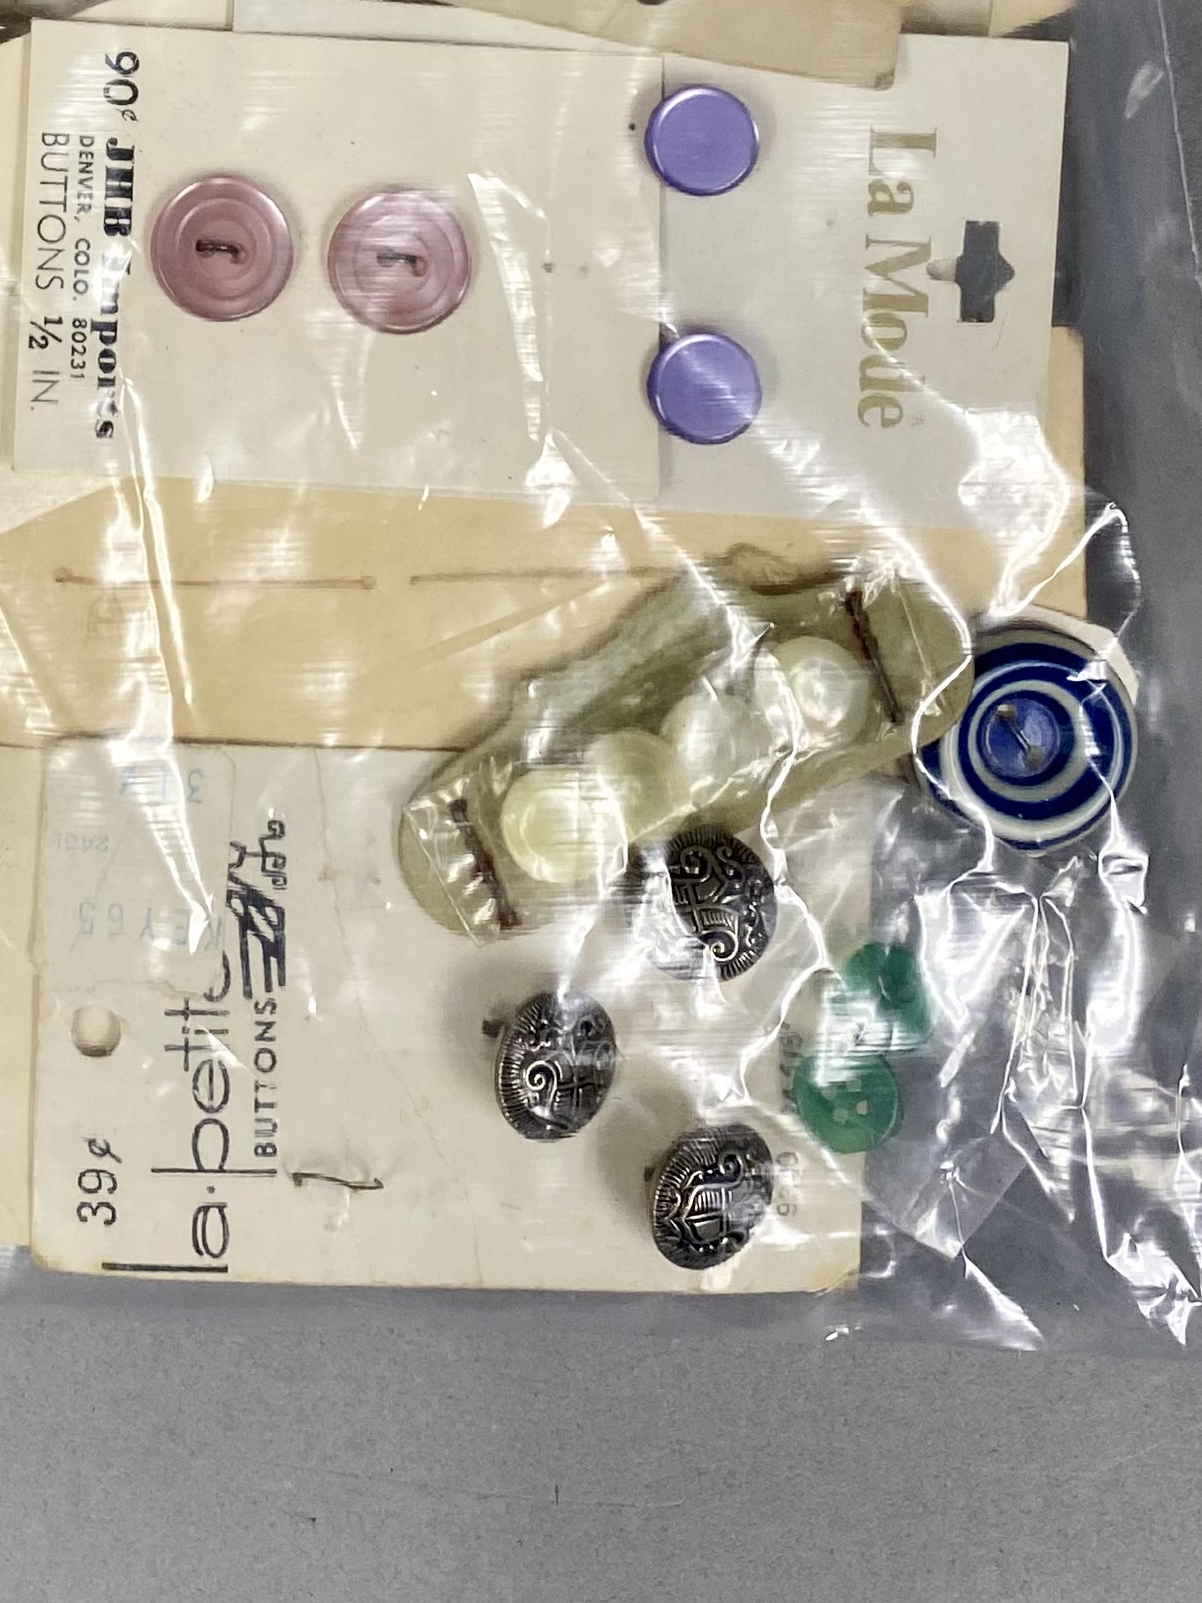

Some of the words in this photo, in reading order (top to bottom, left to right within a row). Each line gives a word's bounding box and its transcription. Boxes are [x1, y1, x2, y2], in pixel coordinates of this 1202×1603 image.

[35, 132, 70, 291] BUTTONS
[73, 135, 95, 222] DENVER,
[103, 137, 136, 237] JHB
[867, 125, 937, 217] La
[73, 238, 91, 301] COLO.
[30, 370, 60, 411] IN.
[70, 318, 87, 380] 80231
[253, 999, 277, 1158] BUTTONS
[76, 1136, 121, 1226] 39¢
